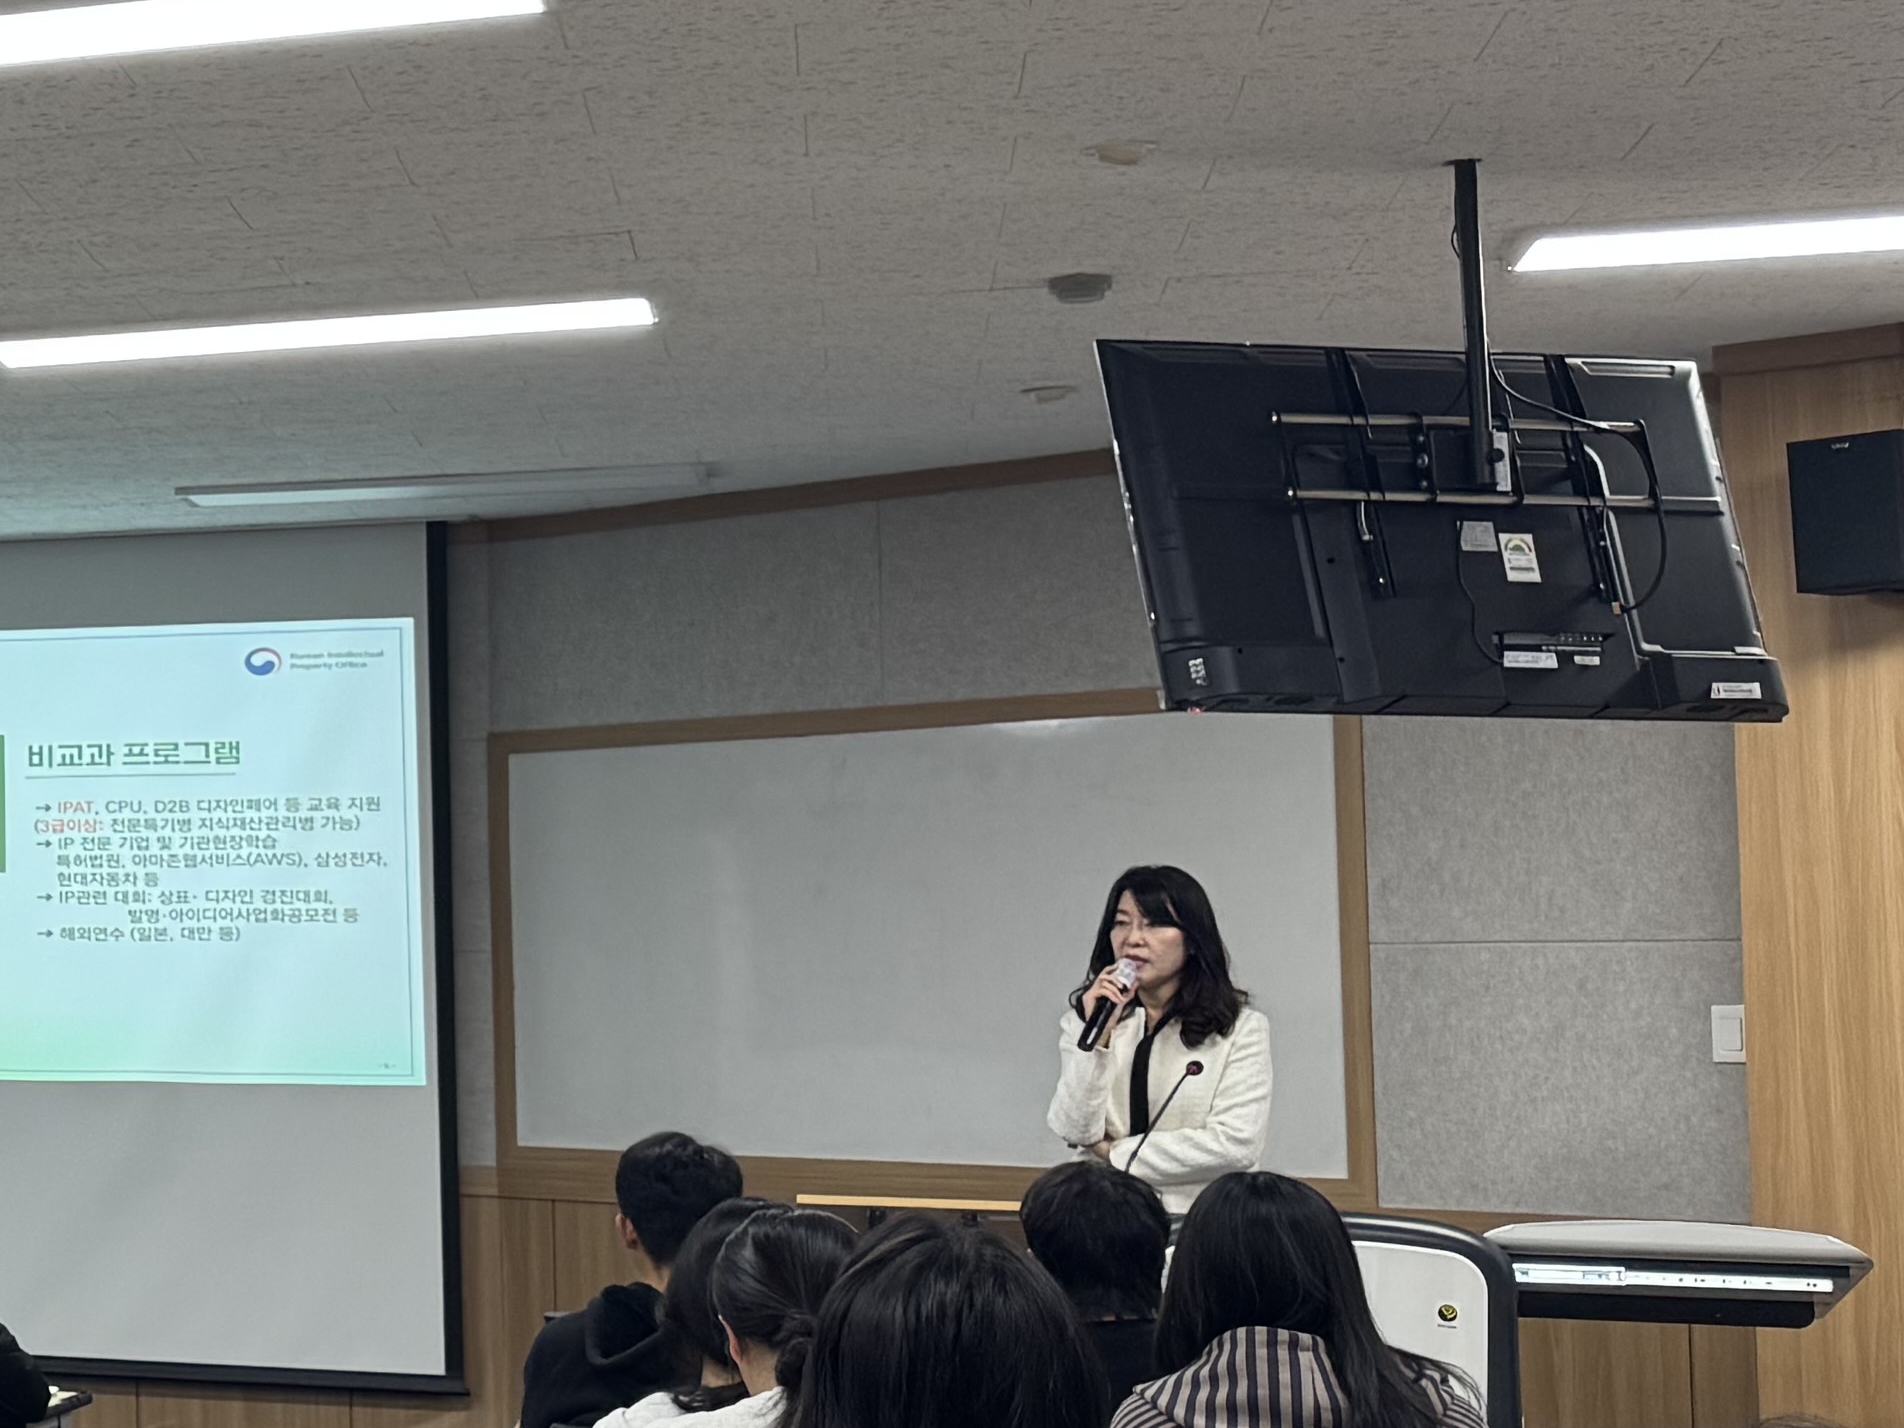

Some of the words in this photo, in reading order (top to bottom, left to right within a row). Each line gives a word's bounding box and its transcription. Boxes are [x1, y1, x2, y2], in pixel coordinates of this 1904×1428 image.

[27, 742, 115, 770] 비교과
[121, 740, 241, 766] 프로그램
[154, 800, 190, 814] D2B
[196, 797, 278, 814] 디자인페어
[284, 797, 301, 813] 등
[306, 797, 342, 812] 교육
[347, 796, 382, 812] 지원
[110, 818, 193, 833] 전문특기병
[197, 816, 315, 832] 지식재산관리병
[320, 815, 361, 831] 가능)
[57, 837, 75, 851] IP
[80, 836, 112, 851] 전문
[118, 836, 150, 851] 기업
[156, 836, 173, 851] 및
[178, 834, 278, 850] 기관현장학습
[57, 871, 138, 887] 현대자동차
[143, 872, 160, 887] 등
[58, 890, 108, 905] IP관련
[204, 889, 254, 905] 디자인
[127, 907, 338, 923] 발명·아이디어사업화공모전
[342, 907, 360, 923] 등
[59, 926, 126, 942] 해외연수
[180, 926, 213, 942] 대만
[217, 926, 241, 942] 등)
